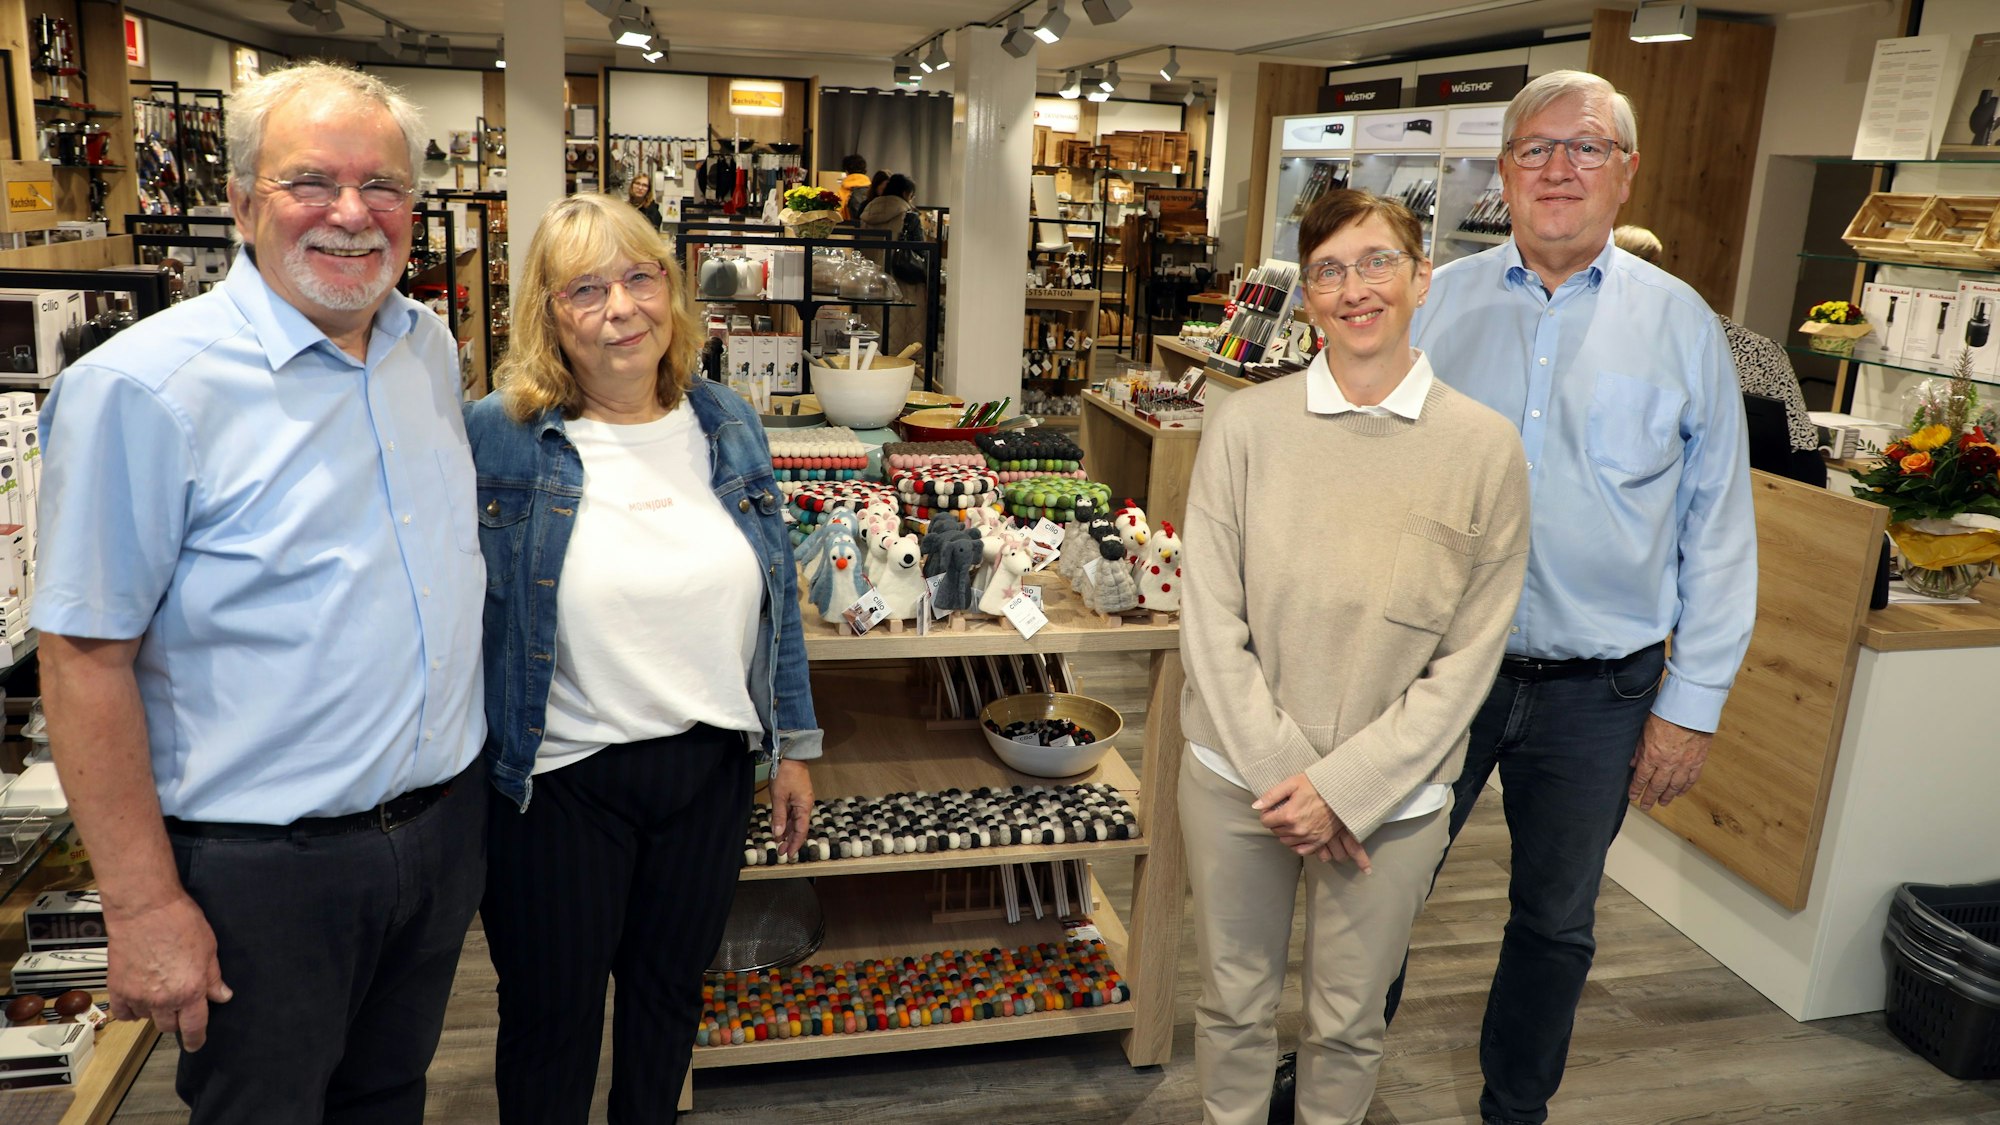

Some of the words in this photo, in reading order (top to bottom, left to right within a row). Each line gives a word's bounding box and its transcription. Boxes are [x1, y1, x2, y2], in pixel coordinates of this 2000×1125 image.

[1451, 81, 1493, 93] WÜSTHOF
[1344, 92, 1376, 102] WÜSTHOF
[41, 300, 59, 312] cilio
[1044, 523, 1059, 535] cilio
[873, 596, 885, 611] cilio
[1009, 598, 1022, 609] cilio
